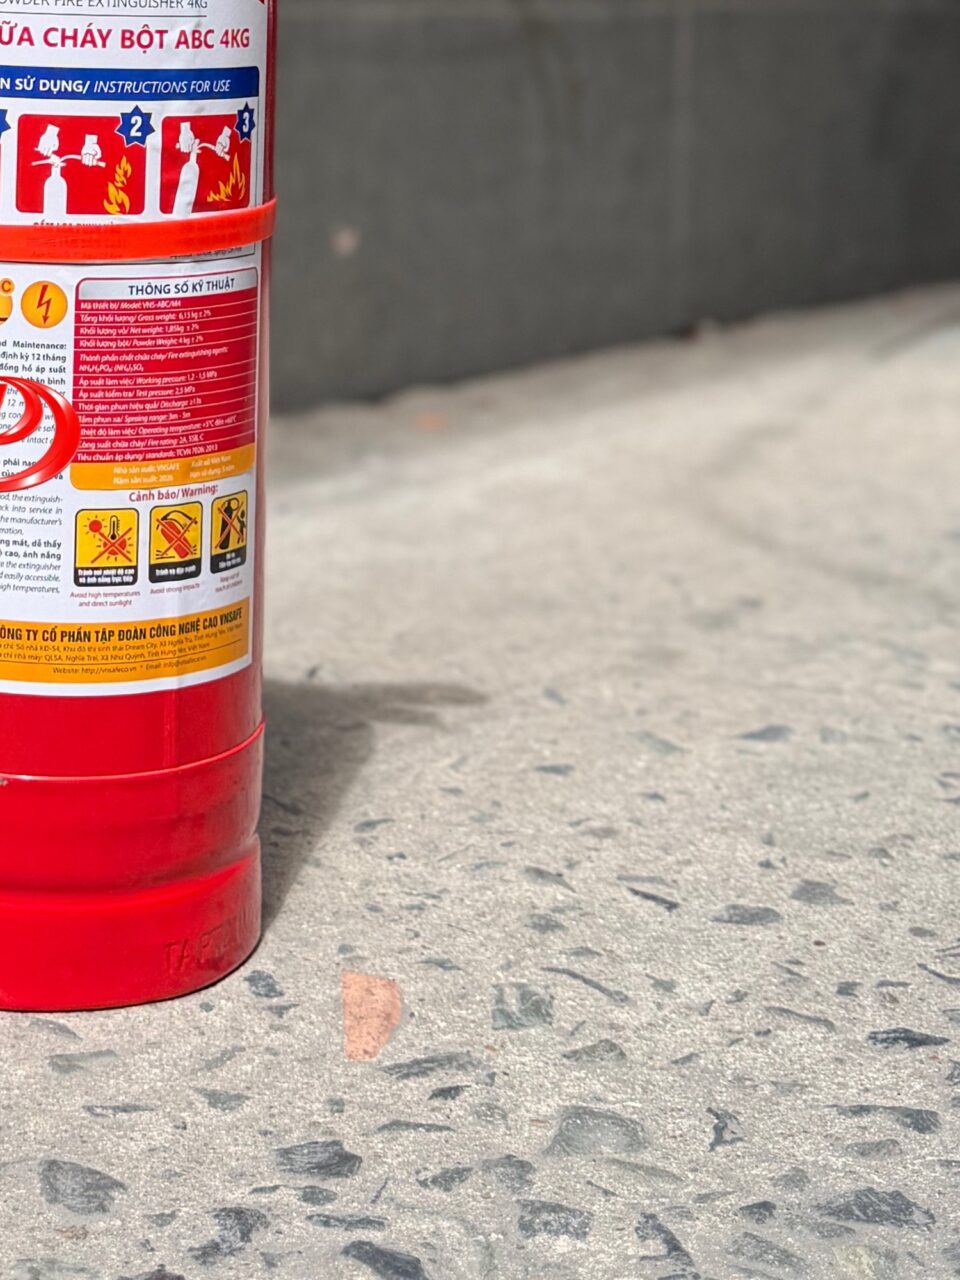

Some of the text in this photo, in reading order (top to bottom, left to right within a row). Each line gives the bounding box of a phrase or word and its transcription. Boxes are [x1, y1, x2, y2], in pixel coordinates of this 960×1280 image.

[43, 23, 112, 48] CHÁY
[121, 24, 168, 54] BỘT
[175, 29, 214, 49] ABC
[220, 28, 250, 48] 4KG
[15, 75, 36, 91] SỬ
[39, 79, 90, 94] DỤNG/
[94, 81, 188, 94] INSTRUCTIONS
[190, 80, 209, 93] FOR
[213, 80, 231, 92] USE
[130, 116, 142, 136] 2
[242, 112, 249, 133] 3
[1, 281, 11, 291] C
[129, 278, 235, 296] THÔNG SỐ KỸ THUẬT
[13, 340, 66, 349] Maintenance:
[0, 351, 18, 360] định
[42, 354, 66, 363] tháng
[35, 366, 45, 374] áp
[129, 485, 218, 503] Cảnh báo/ Warning:
[26, 629, 38, 641] TY
[95, 628, 115, 644] TẬP
[118, 626, 146, 641] ĐOÀN
[149, 623, 176, 639] CÔNG
[179, 617, 200, 634] NGHỆ
[203, 615, 218, 630] CAO
[219, 607, 242, 626] VNSAFE
